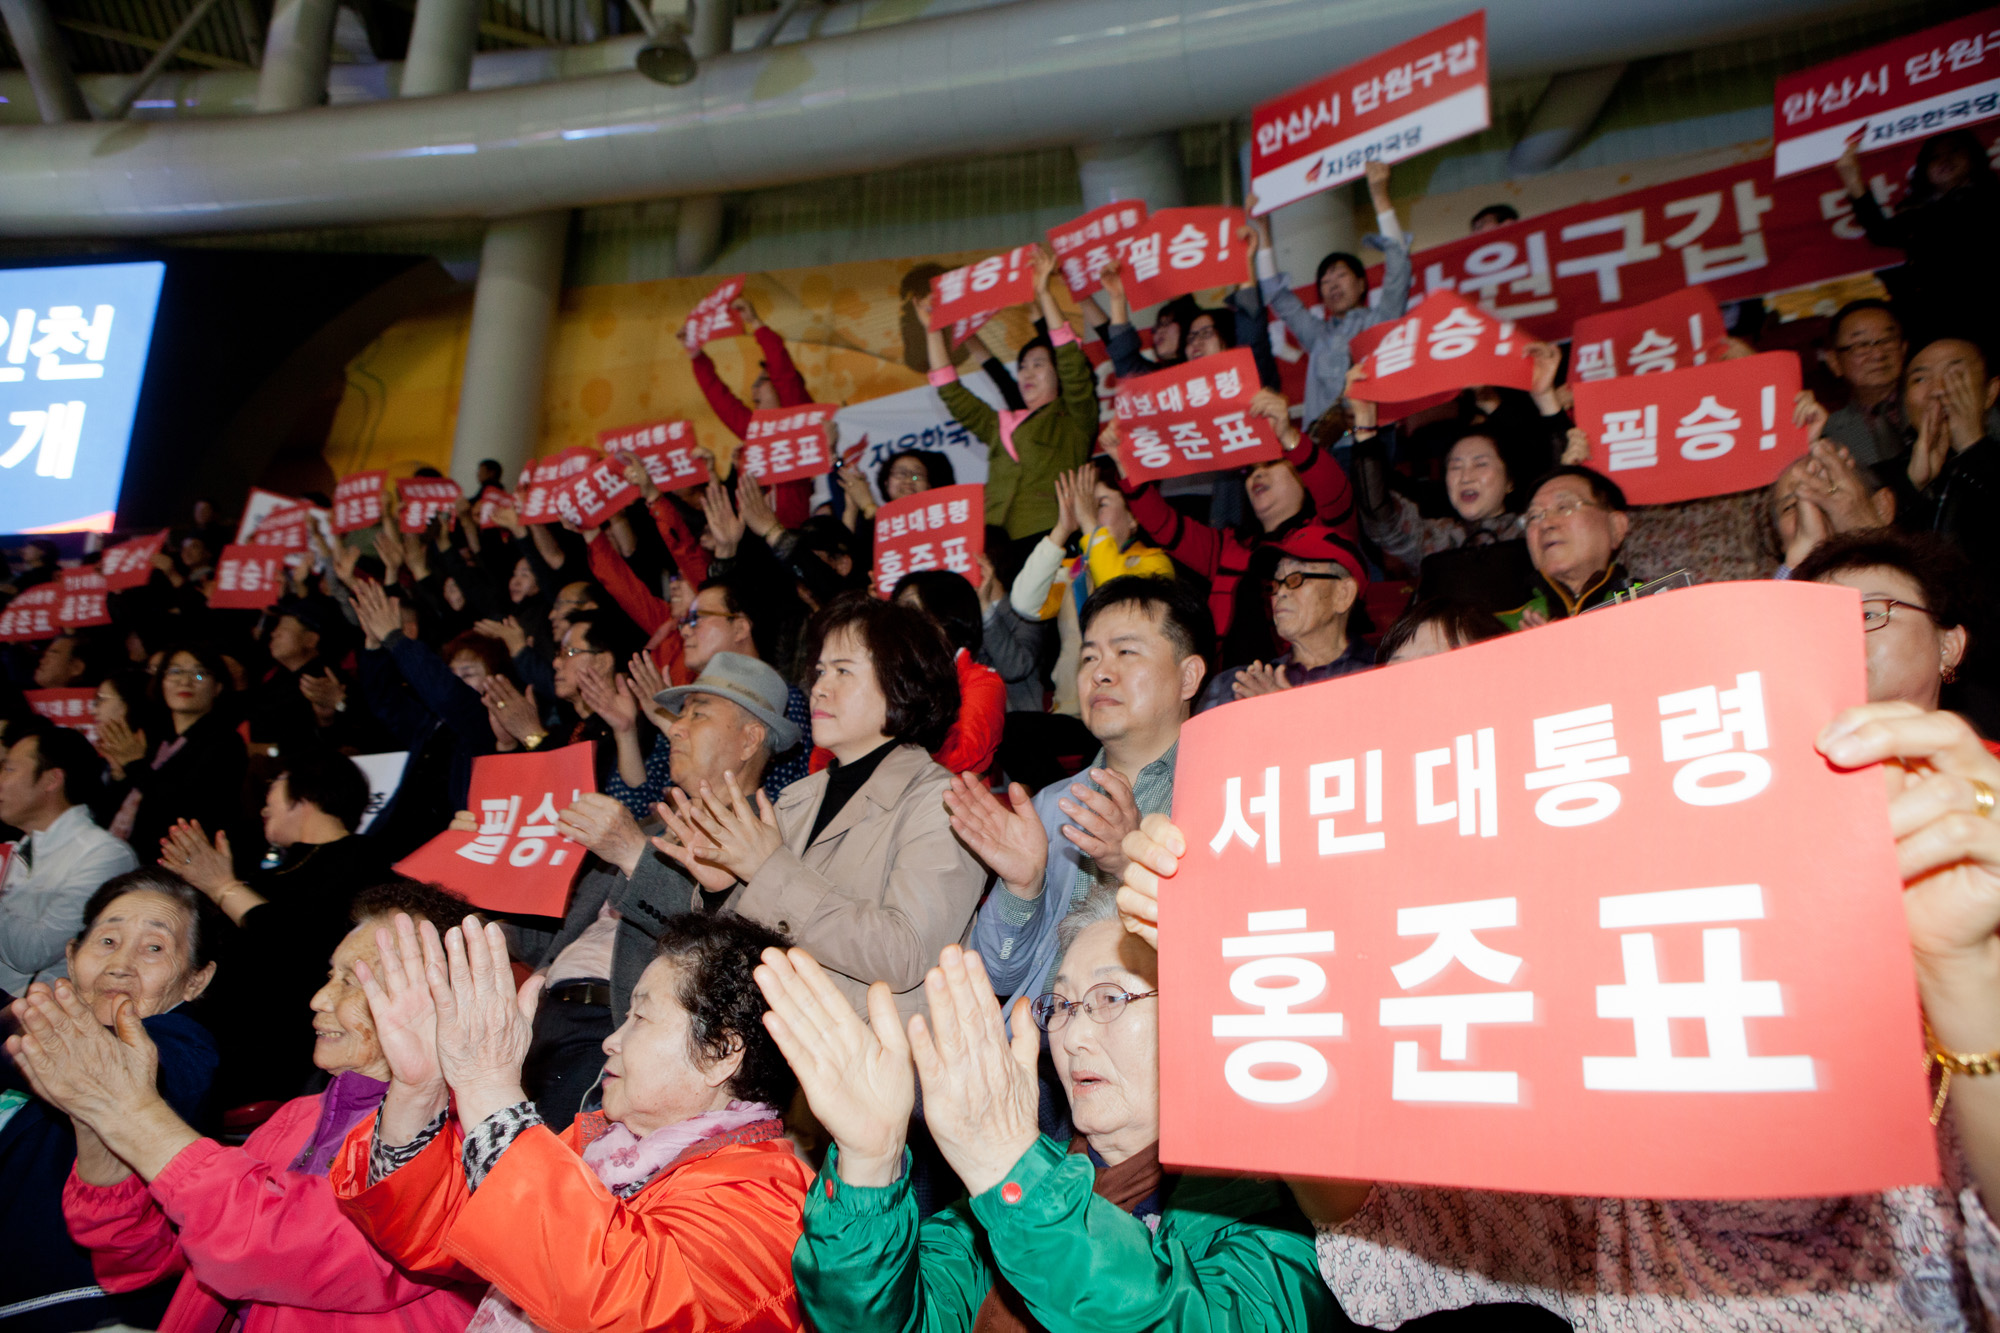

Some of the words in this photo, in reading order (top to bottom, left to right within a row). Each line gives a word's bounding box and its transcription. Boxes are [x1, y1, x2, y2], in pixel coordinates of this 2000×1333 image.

[1256, 92, 1341, 157] 안산시
[1351, 36, 1479, 117] 단원구갑
[1782, 64, 1889, 126] 안산시
[1872, 91, 2000, 143] 자유한국당
[938, 247, 1022, 304] 필승!
[1128, 217, 1231, 284] 필승!
[1373, 305, 1515, 378] 필승!
[1576, 312, 1706, 381] 필승!
[1115, 367, 1241, 420] 안보대통령
[743, 434, 824, 478] 홍준표
[1129, 411, 1262, 468] 홍준표
[1601, 385, 1777, 472] 필승!
[556, 464, 629, 526] 홍준표
[643, 447, 697, 485] 준표
[218, 558, 277, 591] 필승!
[1210, 670, 1773, 864] 서민대통령
[1211, 884, 1819, 1105] 홍준표
